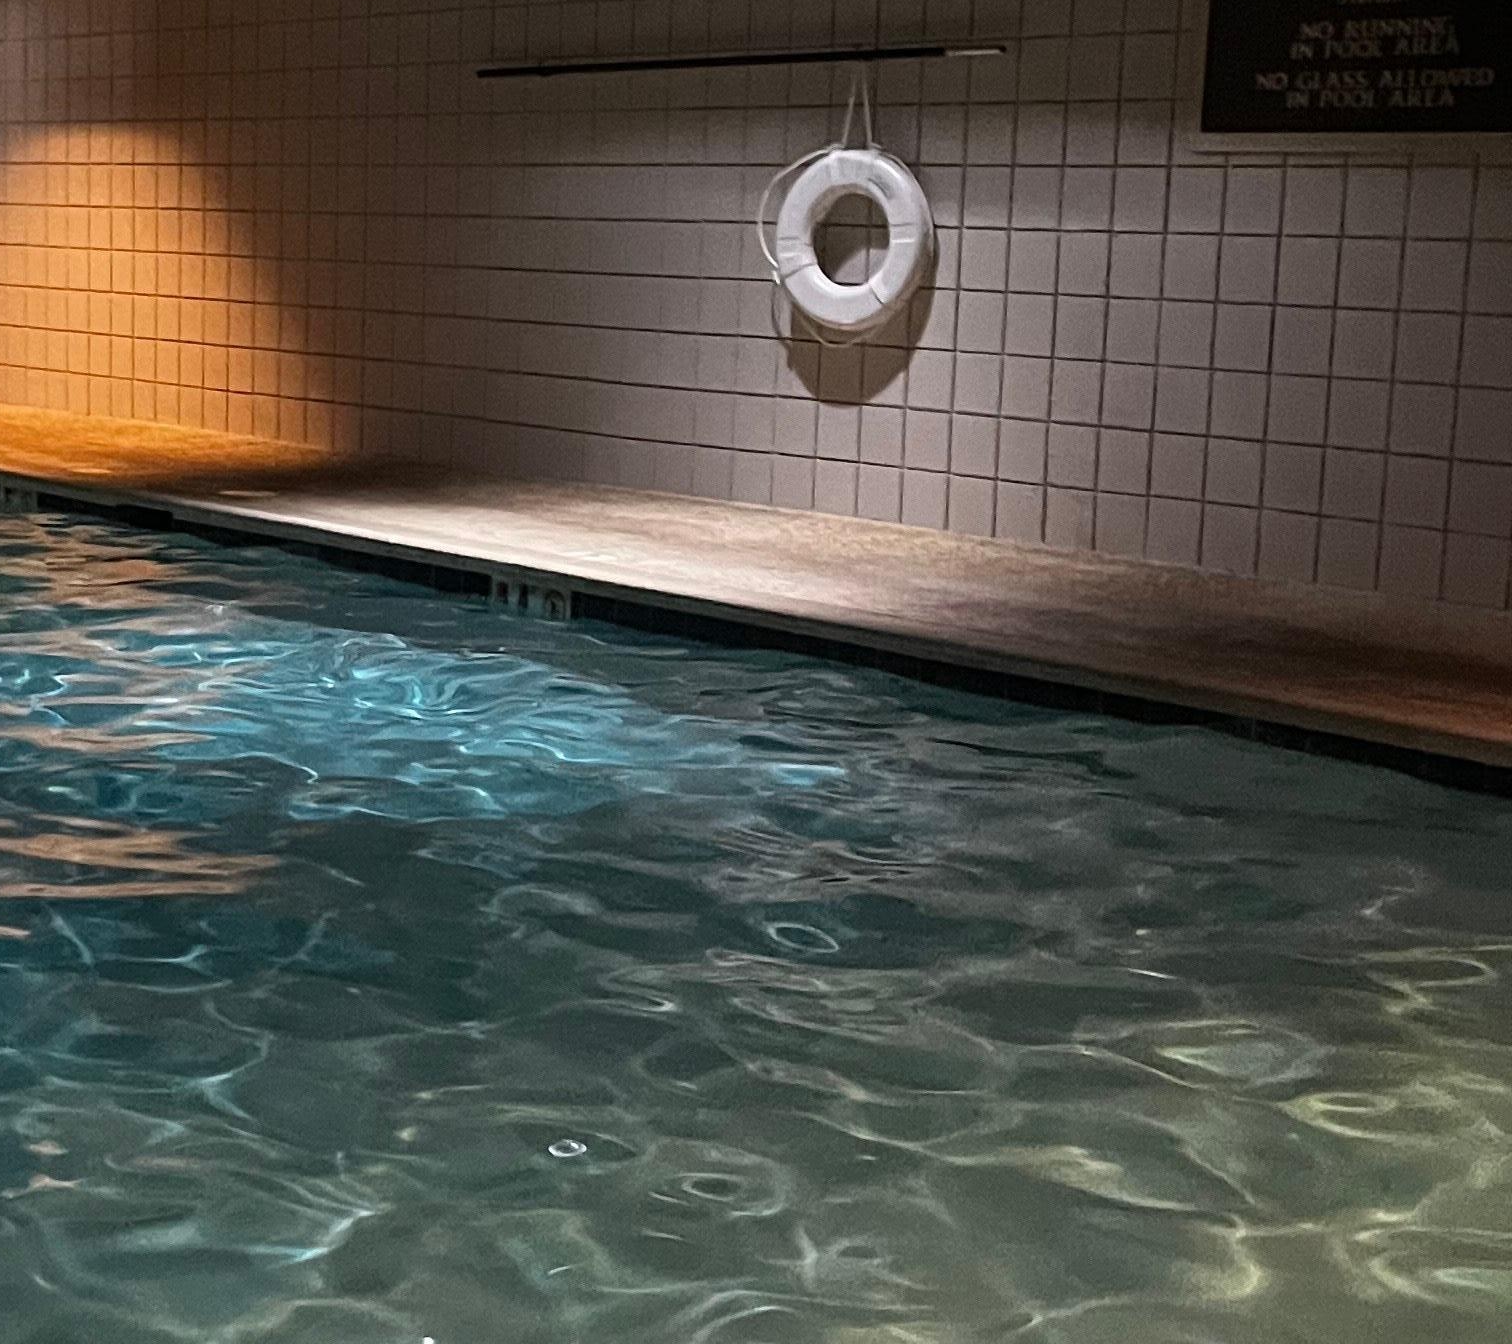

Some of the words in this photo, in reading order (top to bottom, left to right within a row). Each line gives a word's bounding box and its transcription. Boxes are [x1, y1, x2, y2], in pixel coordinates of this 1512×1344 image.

[1299, 21, 1335, 40] NO
[1289, 42, 1314, 60] IN
[1323, 38, 1382, 59] POOL
[1393, 32, 1460, 56] AREA
[1255, 72, 1289, 91] NO
[1295, 70, 1370, 90] GLASS
[1379, 67, 1495, 89] ALLOWED
[1285, 90, 1310, 109] IN
[1319, 88, 1376, 108] POOL
[1387, 86, 1456, 108] AREA
